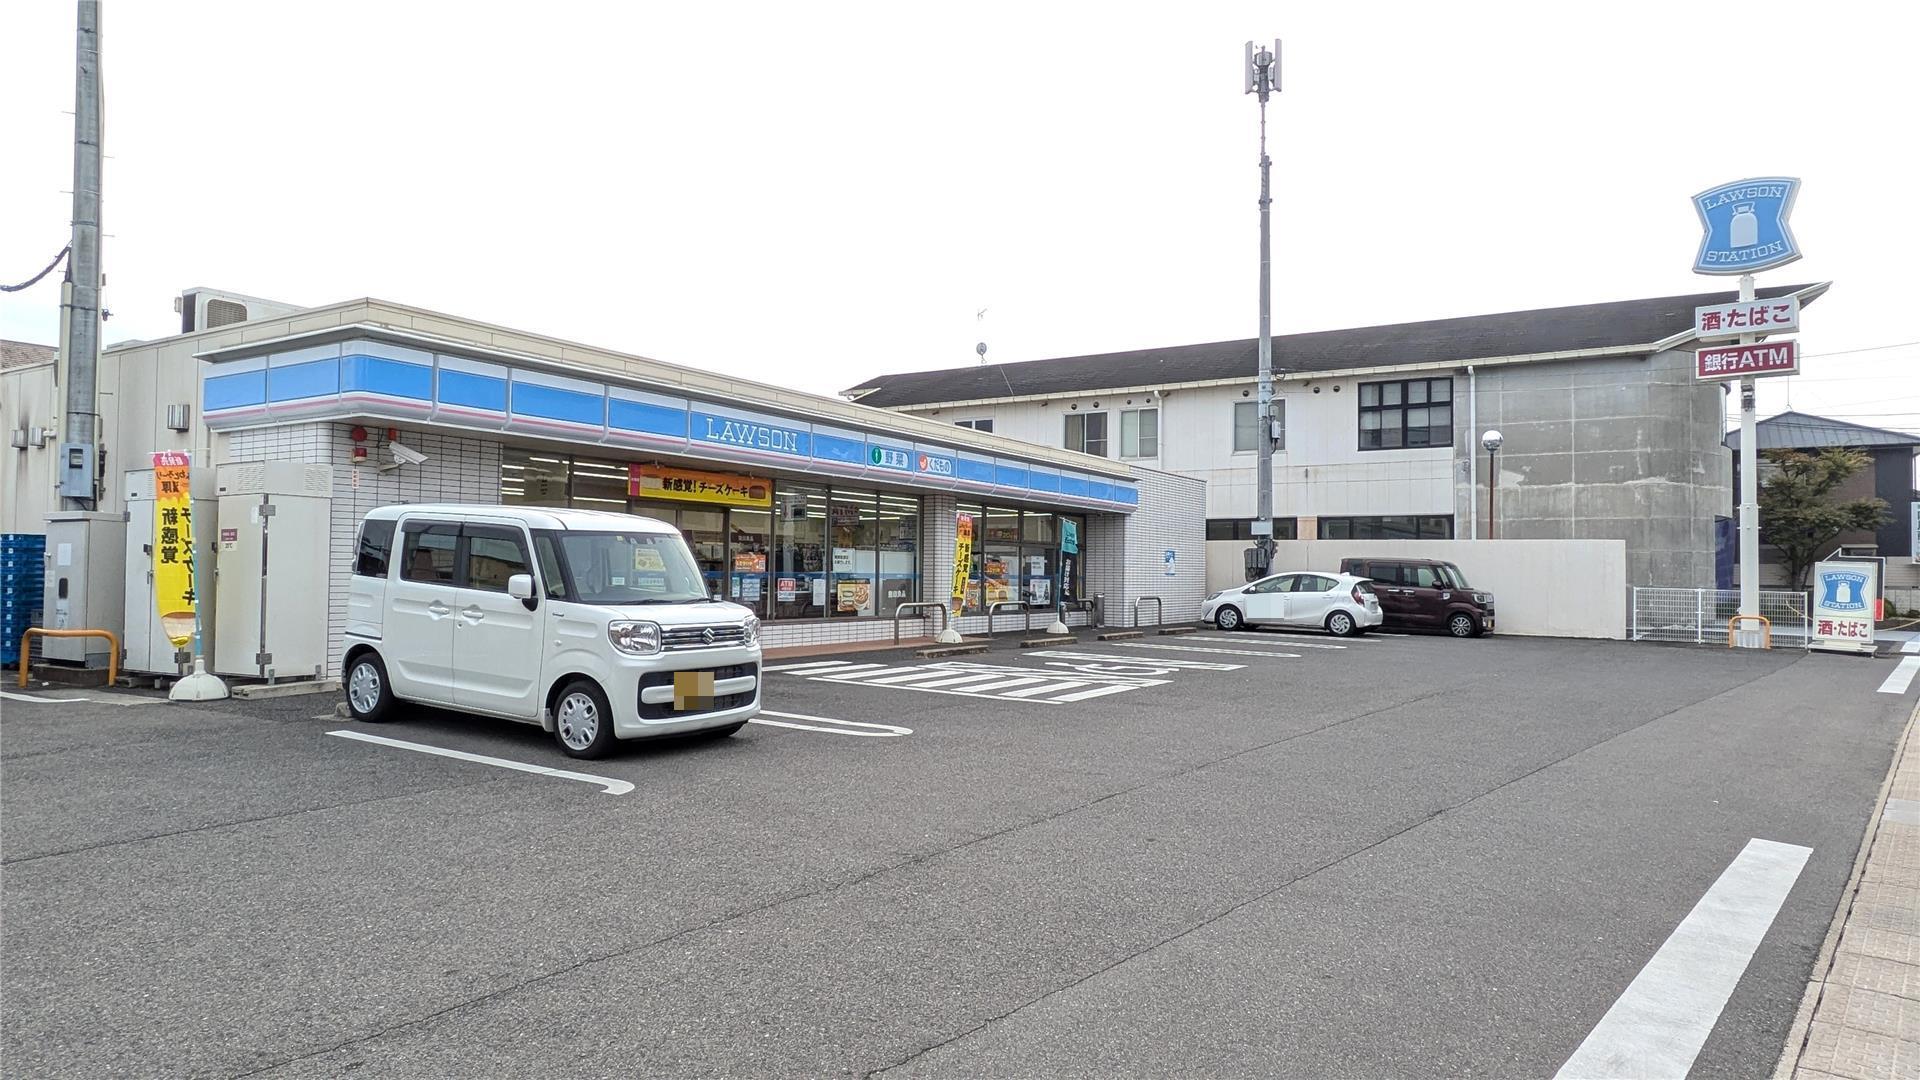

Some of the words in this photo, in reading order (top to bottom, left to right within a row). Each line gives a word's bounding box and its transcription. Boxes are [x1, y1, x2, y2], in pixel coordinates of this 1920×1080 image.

[1704, 185, 1784, 211] LAWSON
[1706, 240, 1784, 263] STATION
[1701, 303, 1791, 332] 酒・たばこ
[1703, 346, 1789, 372] 銀行ATM
[706, 417, 798, 452] LAWSON
[885, 451, 904, 467] 野菜
[929, 458, 950, 473] くだもの
[1825, 574, 1864, 583] LAWSON
[1823, 600, 1863, 609] STATION
[1817, 619, 1868, 638] 酒・たばこ
